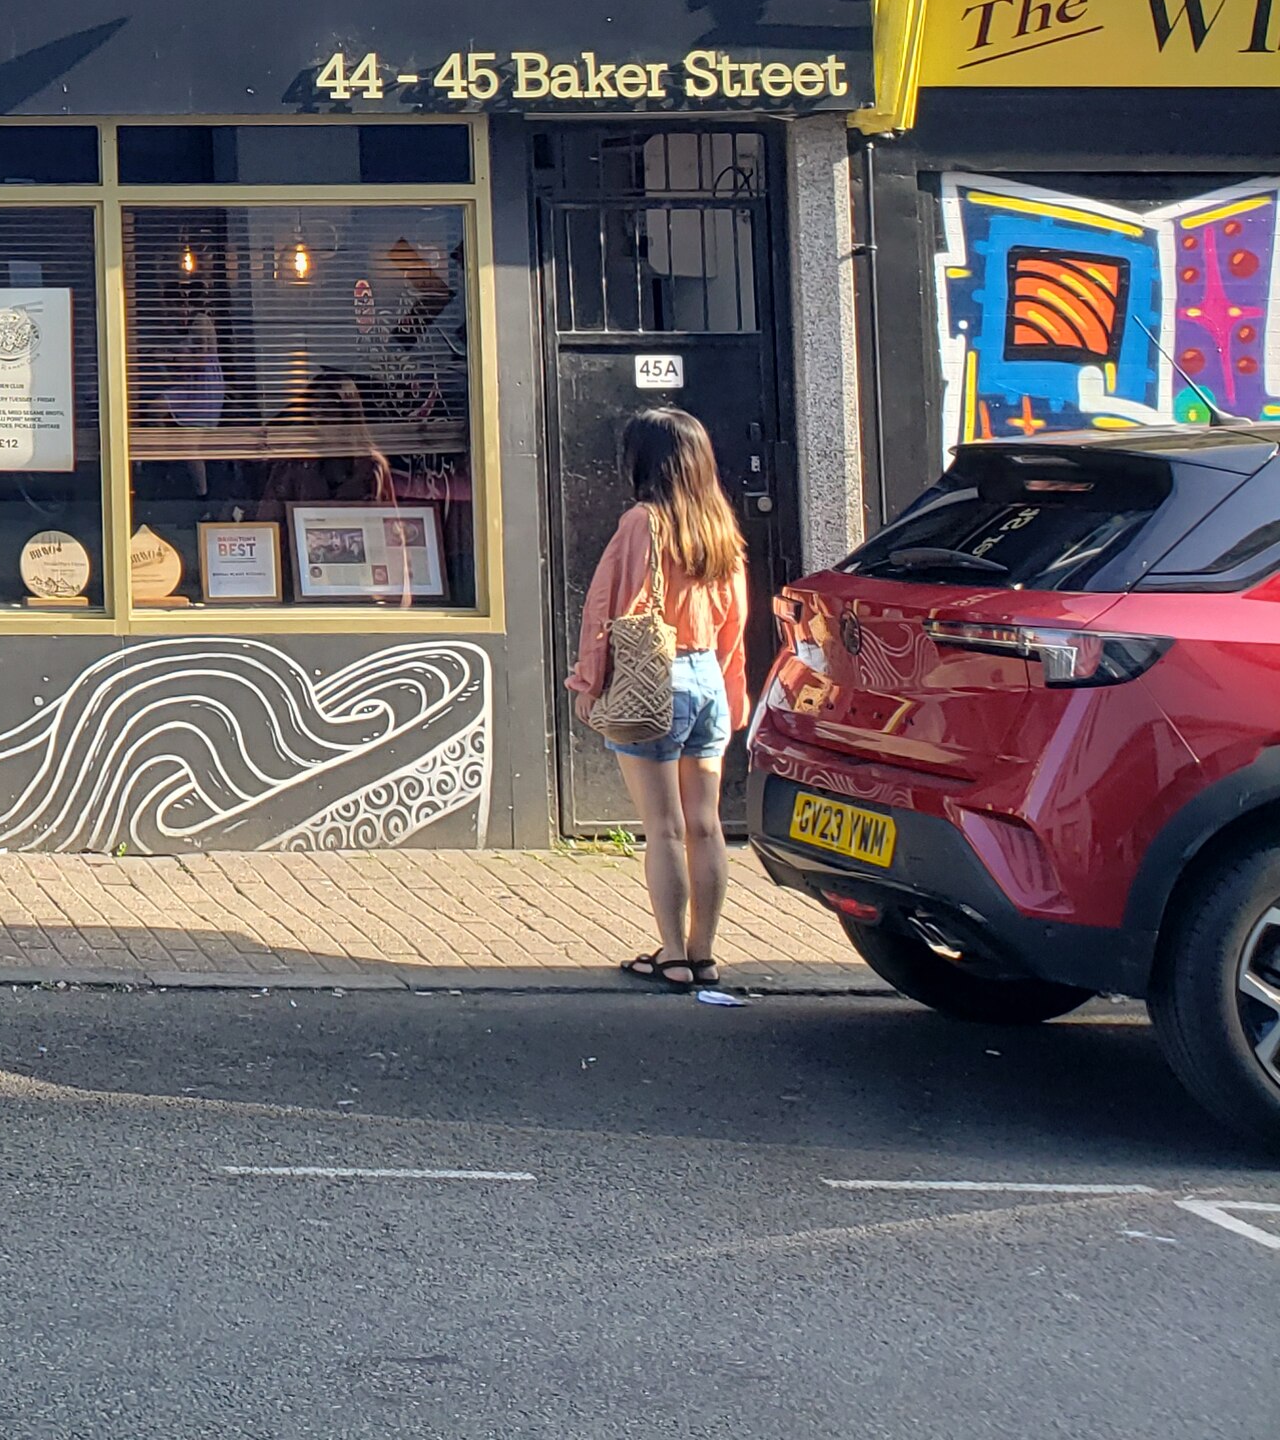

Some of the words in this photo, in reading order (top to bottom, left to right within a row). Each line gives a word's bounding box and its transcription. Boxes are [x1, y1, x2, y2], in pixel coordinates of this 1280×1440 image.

[316, 53, 383, 99] 44
[433, 53, 499, 99] 45
[510, 52, 667, 99] Baker
[684, 50, 847, 98] Street
[640, 360, 678, 377] 45A
[218, 543, 256, 557] BEST
[799, 799, 844, 843] GV23
[848, 811, 887, 857] YWM
